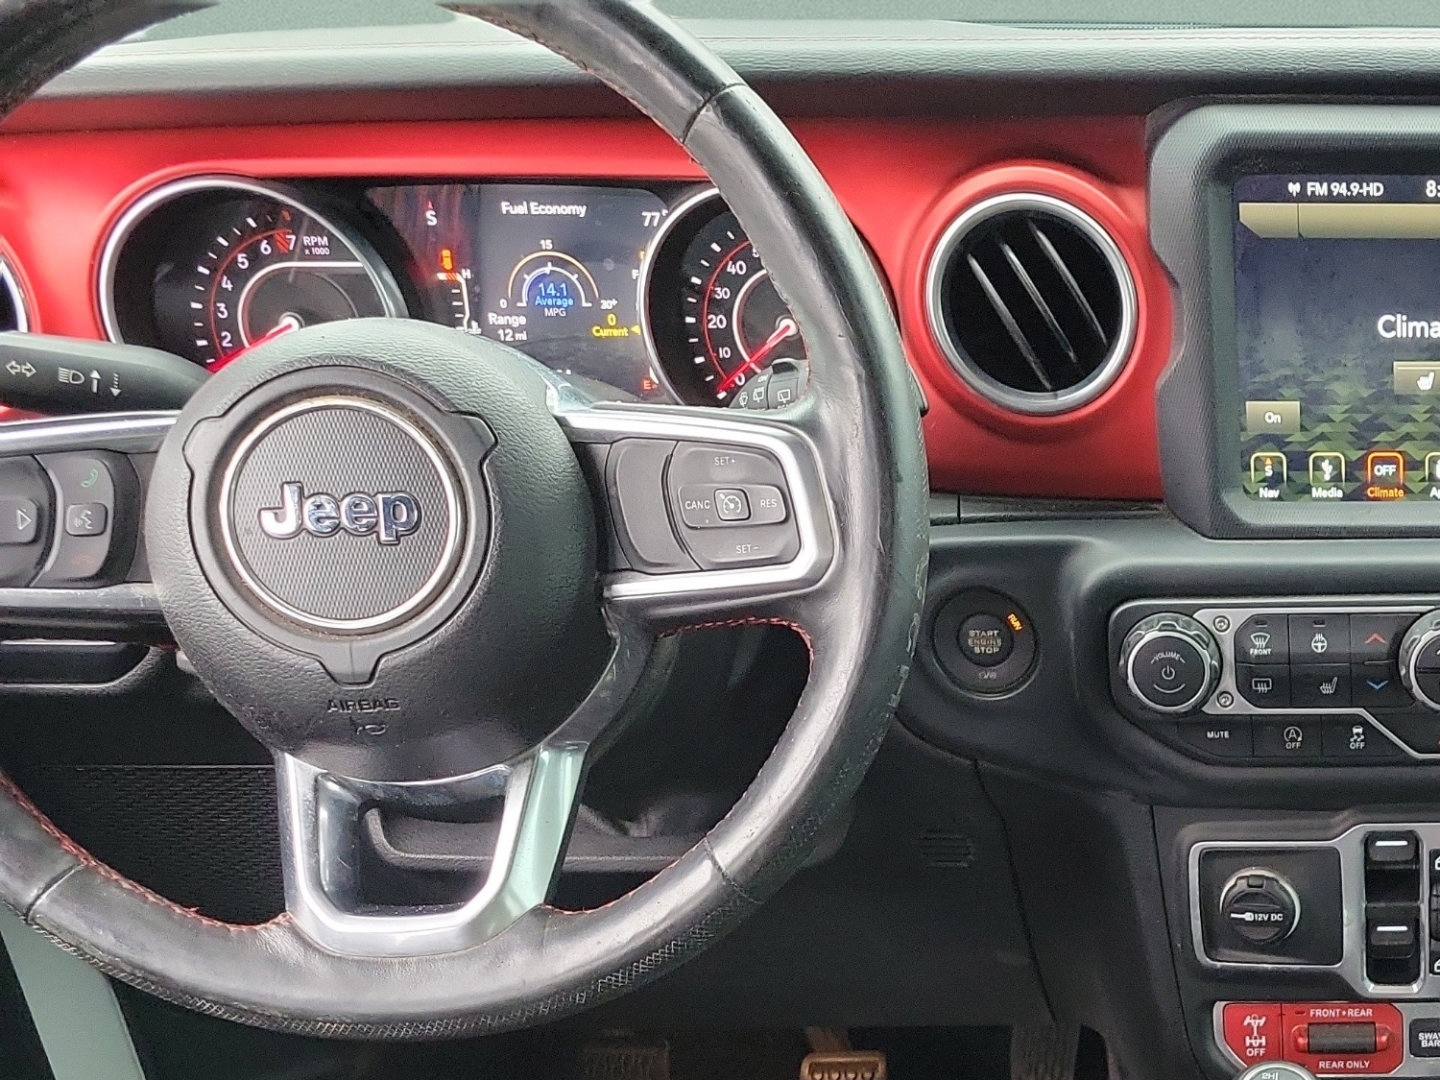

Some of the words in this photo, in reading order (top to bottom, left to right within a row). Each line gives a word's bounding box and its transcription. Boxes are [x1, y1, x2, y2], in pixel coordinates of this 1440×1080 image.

[1307, 182, 1328, 196] FM
[1330, 182, 1384, 196] 94.9-HD
[501, 202, 528, 215] Fuel
[530, 202, 587, 217] Economy
[425, 210, 438, 226] S
[286, 235, 296, 250] 7
[303, 236, 329, 247] RPM
[540, 240, 552, 249] 15
[260, 240, 272, 255] 6
[312, 247, 330, 255] 1000
[237, 253, 249, 269] 5
[727, 261, 747, 275] 40
[462, 269, 471, 279] H
[221, 276, 233, 291] 4
[538, 283, 567, 297] 14.1
[714, 287, 730, 299] 30
[499, 300, 507, 309] 0
[535, 297, 574, 307] Average
[216, 303, 228, 319] 3
[544, 308, 566, 317] MPG
[488, 313, 527, 327] Range
[608, 314, 616, 326] 0
[707, 315, 727, 329] 20
[498, 330, 514, 341] 12
[516, 330, 527, 341] mi
[592, 326, 628, 337] Current
[221, 332, 232, 347] 2
[719, 347, 731, 358] 10
[644, 380, 651, 389] E
[735, 373, 745, 386] 0
[1264, 411, 1282, 424] On
[1264, 466, 1273, 476] S
[1374, 465, 1397, 476] OFF
[1259, 487, 1280, 498] Nav
[1312, 487, 1343, 498] Media
[1367, 487, 1404, 498] Climate
[685, 500, 711, 510] CANC
[760, 499, 777, 508] RES
[259, 482, 421, 545] Jeep
[974, 646, 1000, 654] STOP
[1250, 648, 1271, 656] FRONT
[1153, 651, 1181, 662] VOLUME
[327, 699, 401, 712] AIRBAG
[1207, 731, 1229, 739] MUTE
[1254, 913, 1269, 921] 12V
[1271, 913, 1283, 921] DC
[1421, 1039, 1440, 1047] BAR
[1246, 1048, 1266, 1056] OFF
[1319, 1061, 1344, 1069] REAR
[1346, 1061, 1370, 1069] ONLY
[1261, 1072, 1275, 1080] 2H
